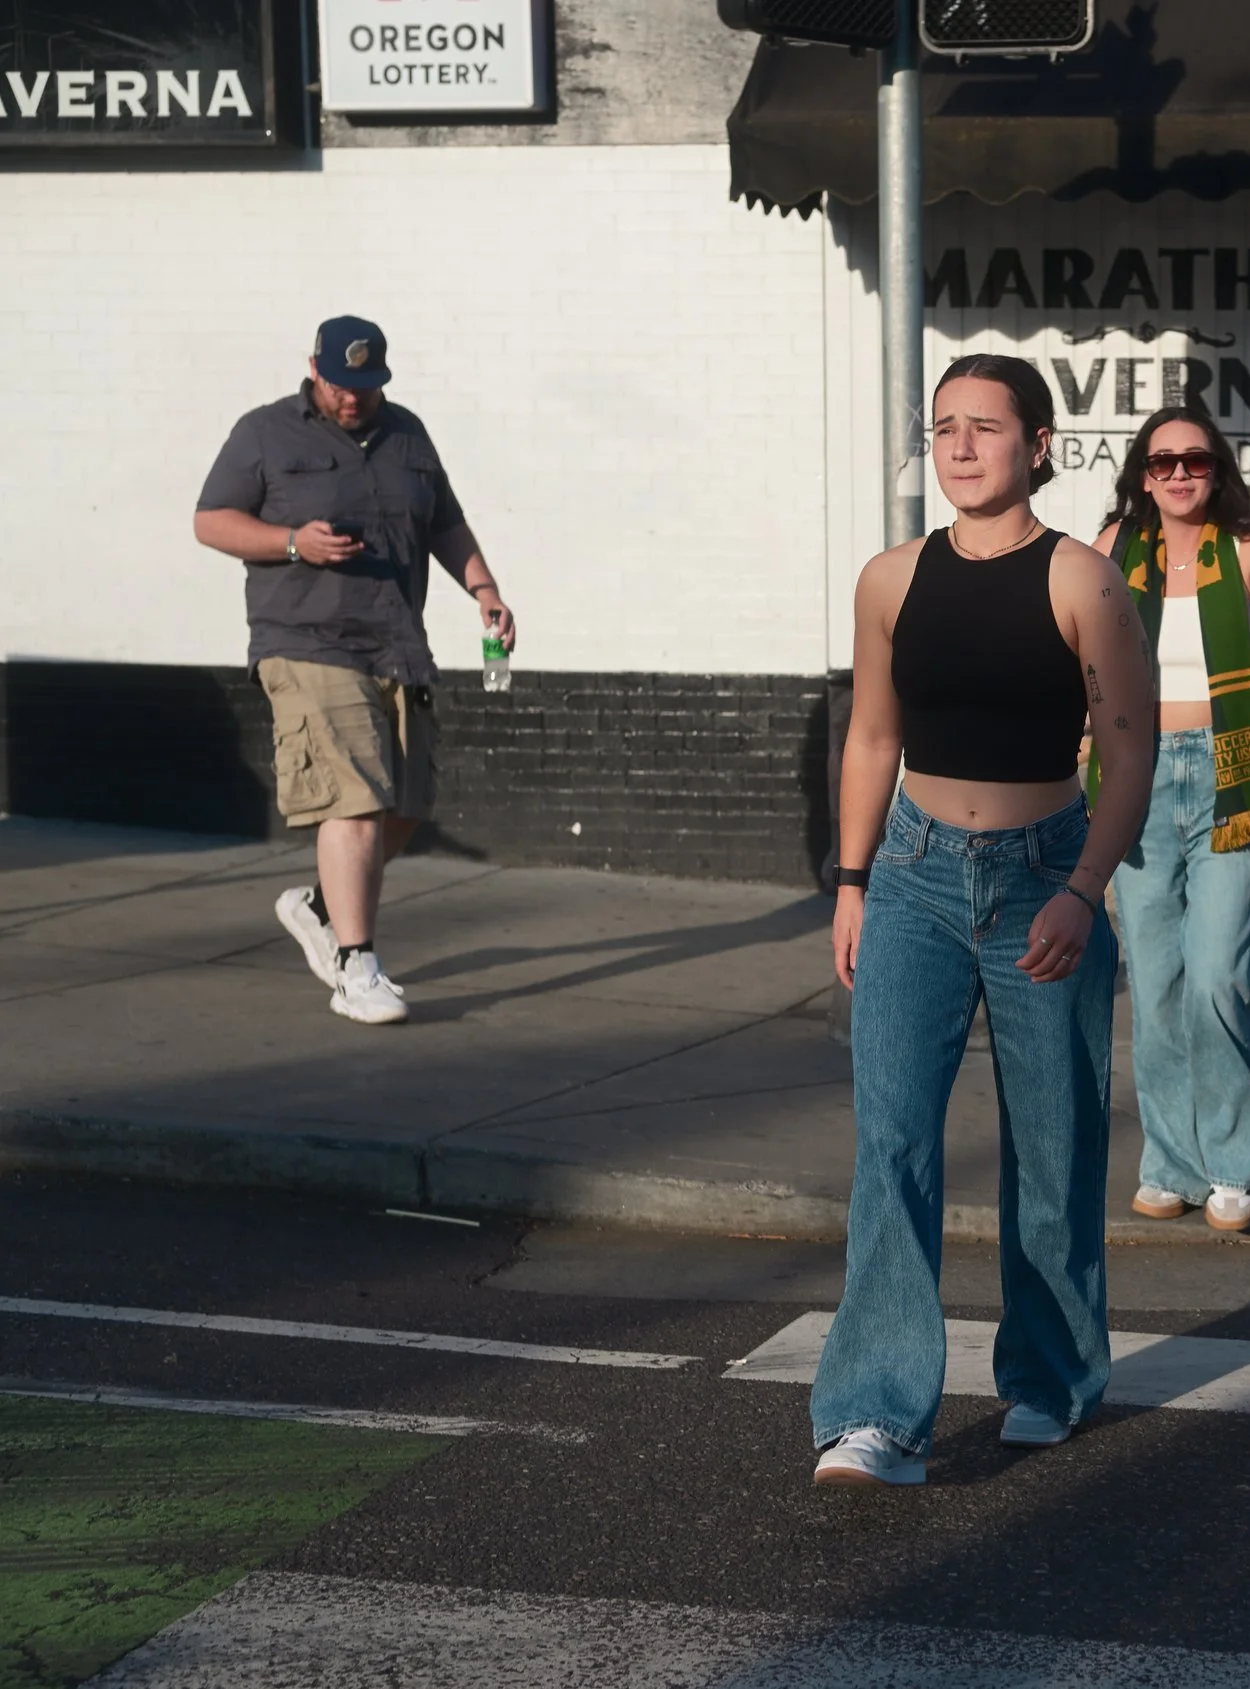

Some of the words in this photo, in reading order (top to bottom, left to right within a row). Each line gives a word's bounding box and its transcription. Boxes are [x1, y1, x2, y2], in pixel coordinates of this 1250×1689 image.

[349, 23, 505, 52] OREGON
[0, 69, 253, 118] VERNA
[1063, 437, 1136, 471] BA
